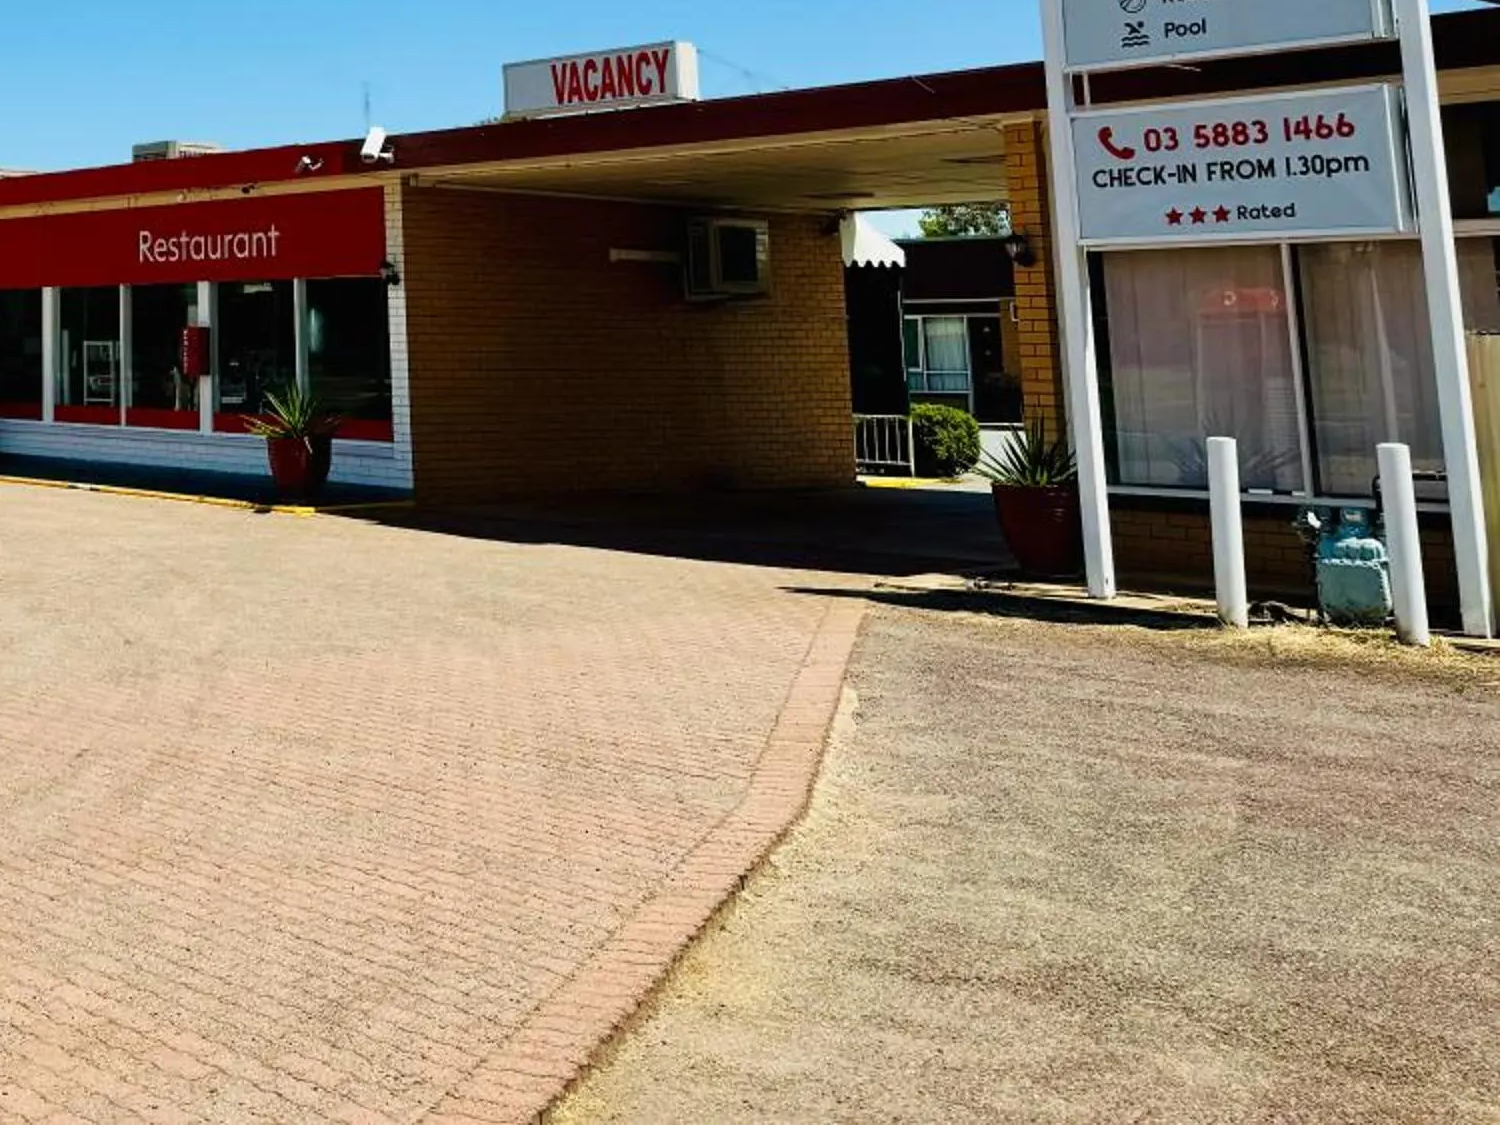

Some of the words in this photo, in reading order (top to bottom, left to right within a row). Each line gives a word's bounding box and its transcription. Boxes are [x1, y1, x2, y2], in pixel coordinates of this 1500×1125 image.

[1163, 17, 1208, 39] Pool
[550, 48, 670, 106] VACANCY
[1143, 127, 1179, 153] 03
[1193, 119, 1269, 149] 5883
[1282, 112, 1356, 143] 1466
[1092, 162, 1197, 189] CHECK-IN
[1206, 157, 1276, 182] FROM
[1286, 153, 1371, 178] 1.30pm
[1236, 202, 1297, 221] Rated
[138, 222, 280, 264] Restaurant
